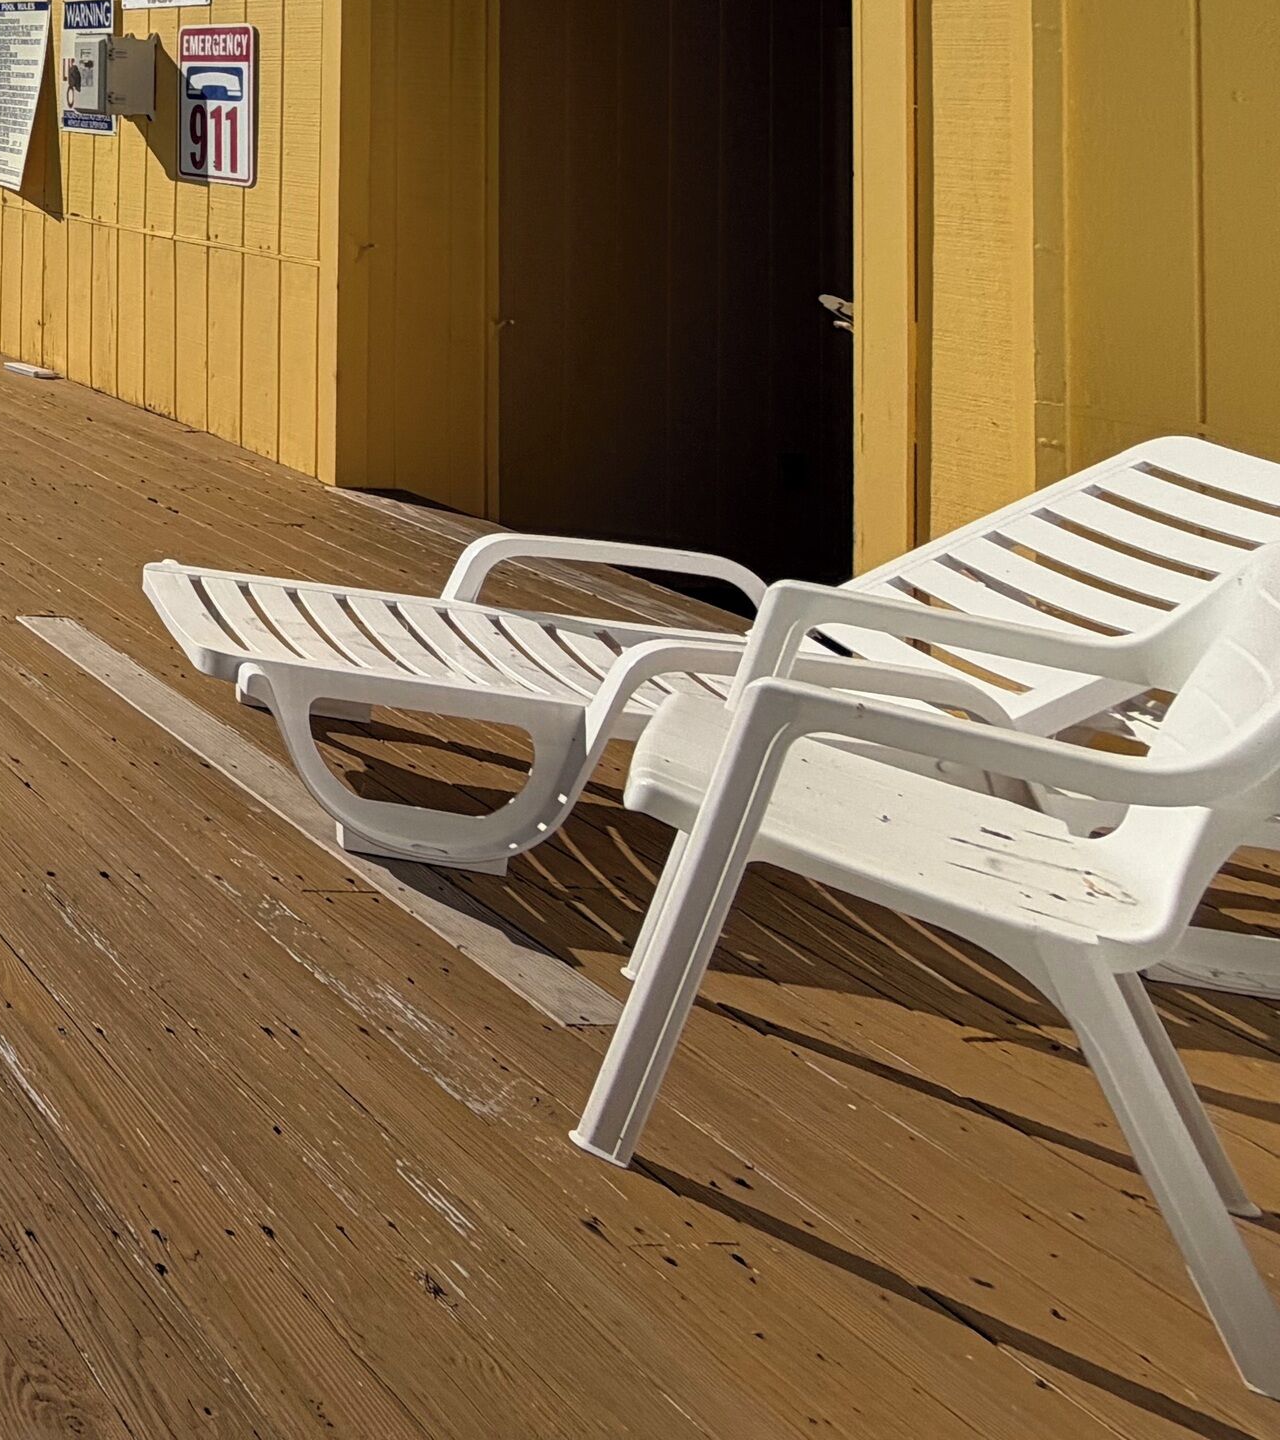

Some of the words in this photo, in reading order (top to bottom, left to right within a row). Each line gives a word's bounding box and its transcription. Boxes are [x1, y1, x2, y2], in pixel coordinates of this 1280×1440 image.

[65, 1, 110, 27] WARNING
[183, 33, 248, 56] EMERGENCY
[190, 104, 238, 173] 911
